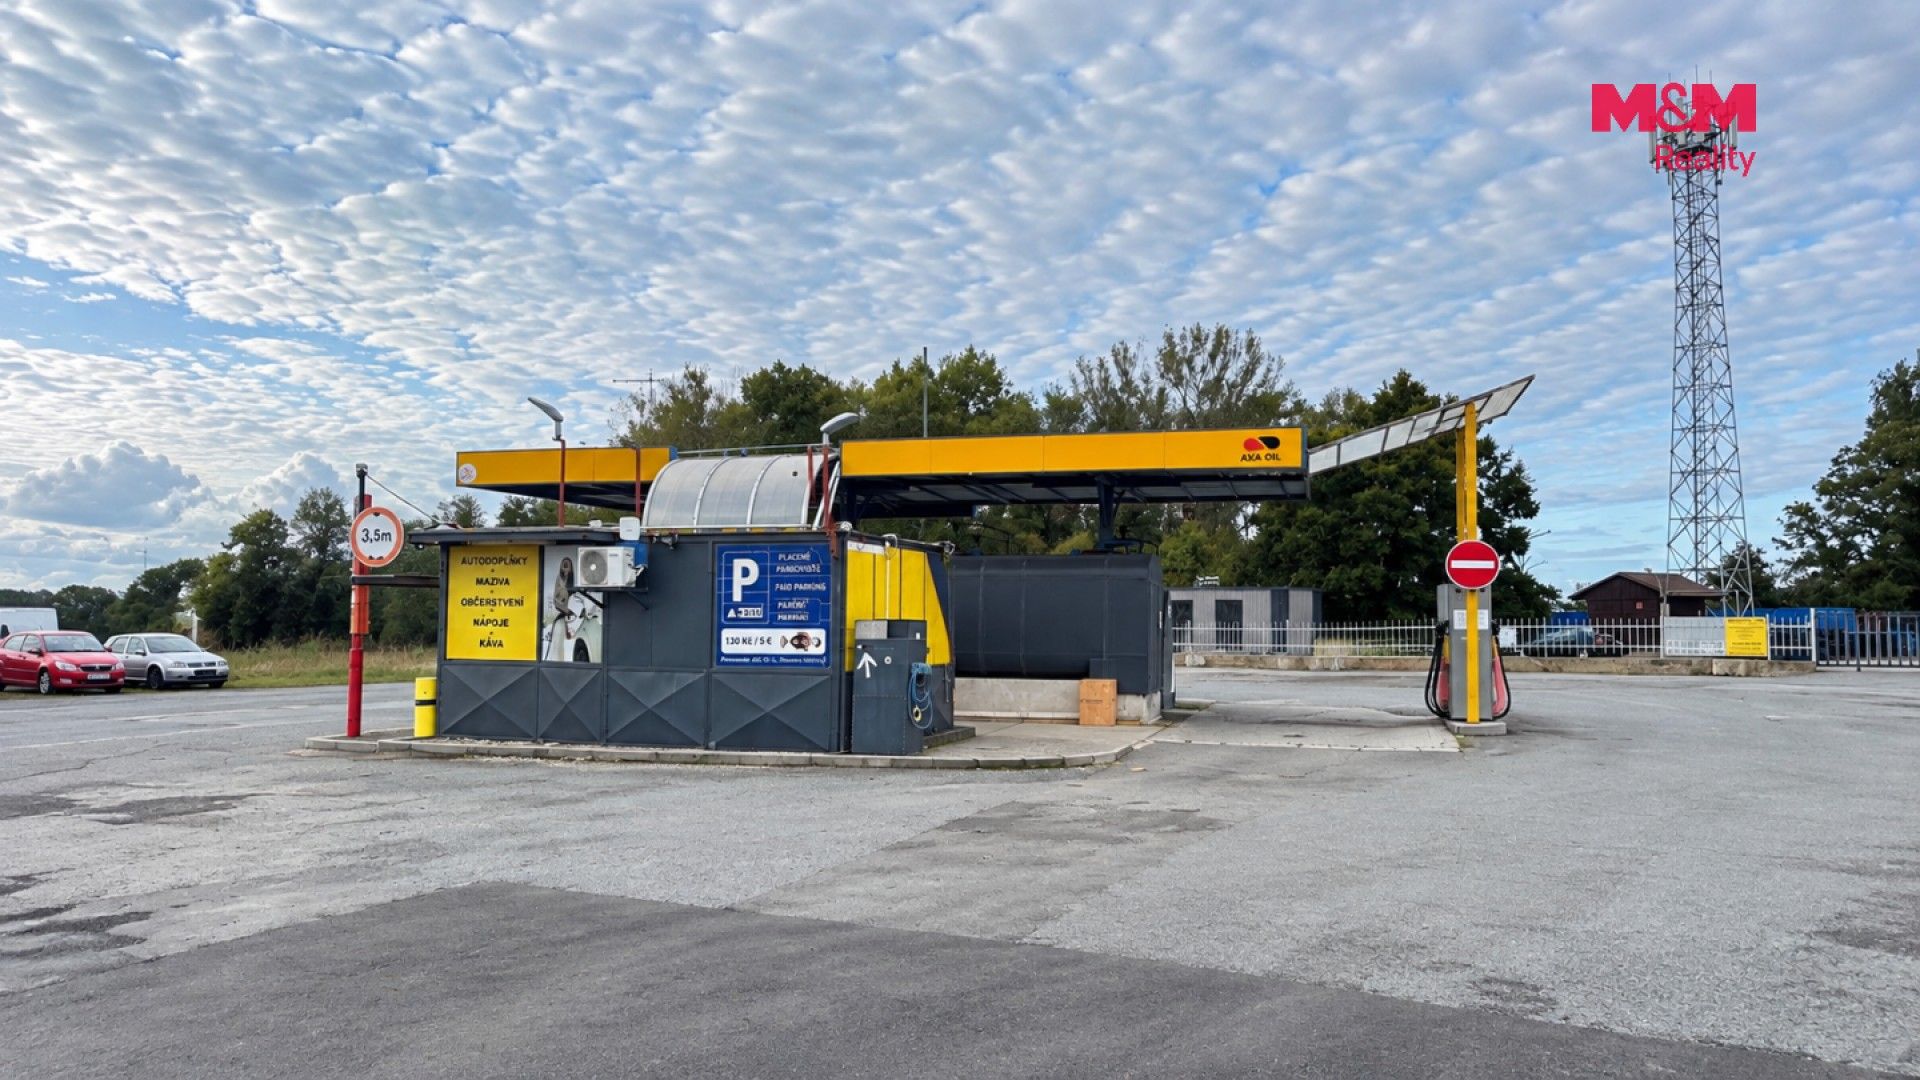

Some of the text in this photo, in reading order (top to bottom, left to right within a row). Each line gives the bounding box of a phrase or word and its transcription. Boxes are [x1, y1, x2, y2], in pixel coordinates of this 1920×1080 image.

[1240, 453, 1281, 462] AXA OIL
[361, 527, 393, 543] 3,5m
[475, 576, 510, 587] MAZIVA
[731, 558, 760, 602] P
[460, 595, 524, 608] OBČERSTVENÍ
[472, 616, 509, 628] NÁPOJE
[479, 635, 504, 648] KÁVA
[759, 636, 765, 645] 5
